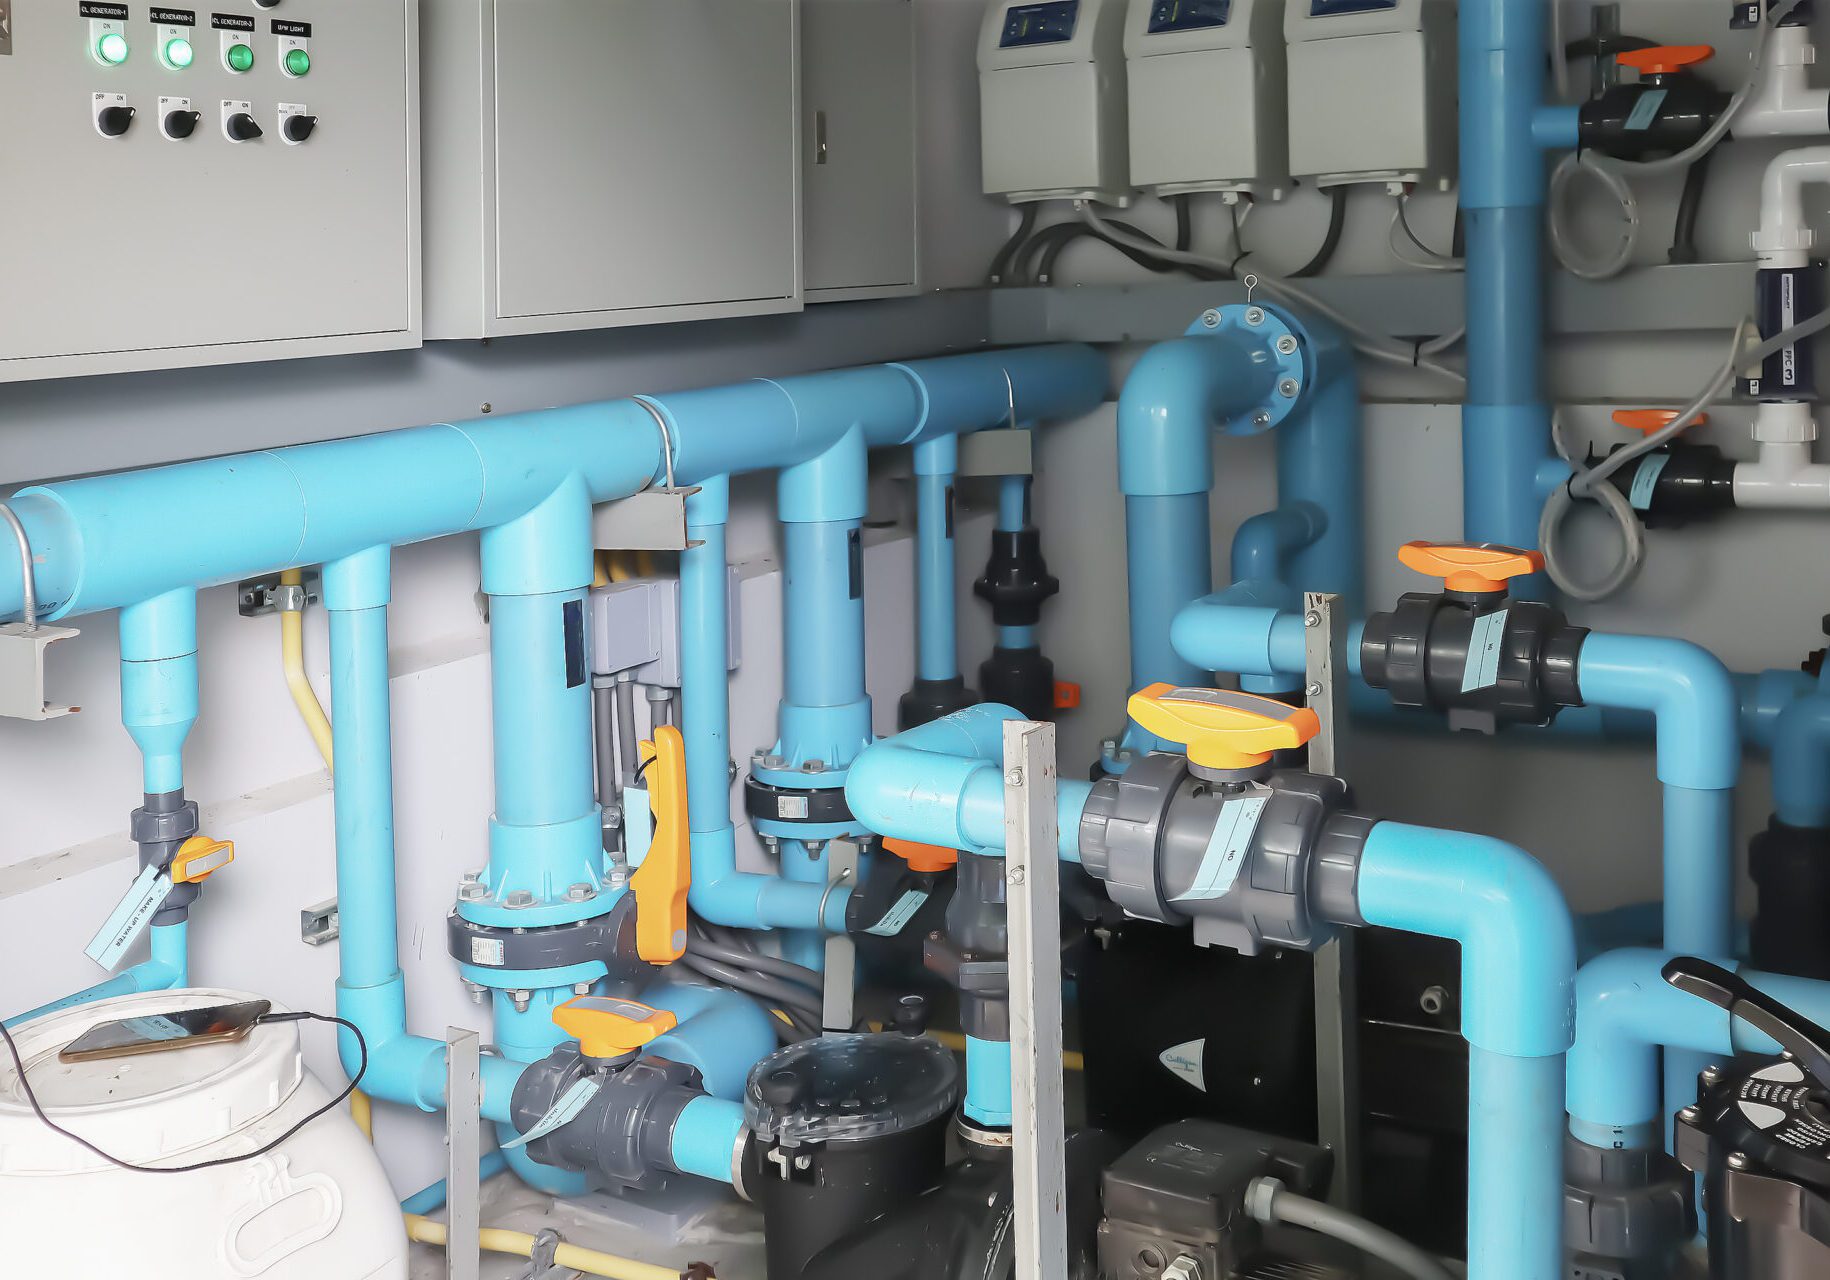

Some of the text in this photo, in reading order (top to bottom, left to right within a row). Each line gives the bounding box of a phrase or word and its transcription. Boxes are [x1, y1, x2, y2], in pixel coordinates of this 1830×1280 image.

[90, 7, 126, 15] GENERATOR-1
[159, 13, 193, 21] GENERATOR-2
[221, 19, 253, 27] GENERATOR-3
[139, 896, 154, 914] MAKE
[131, 916, 139, 926] UP
[115, 925, 133, 947] WATER
[1775, 1134, 1806, 1149] CLOSED
